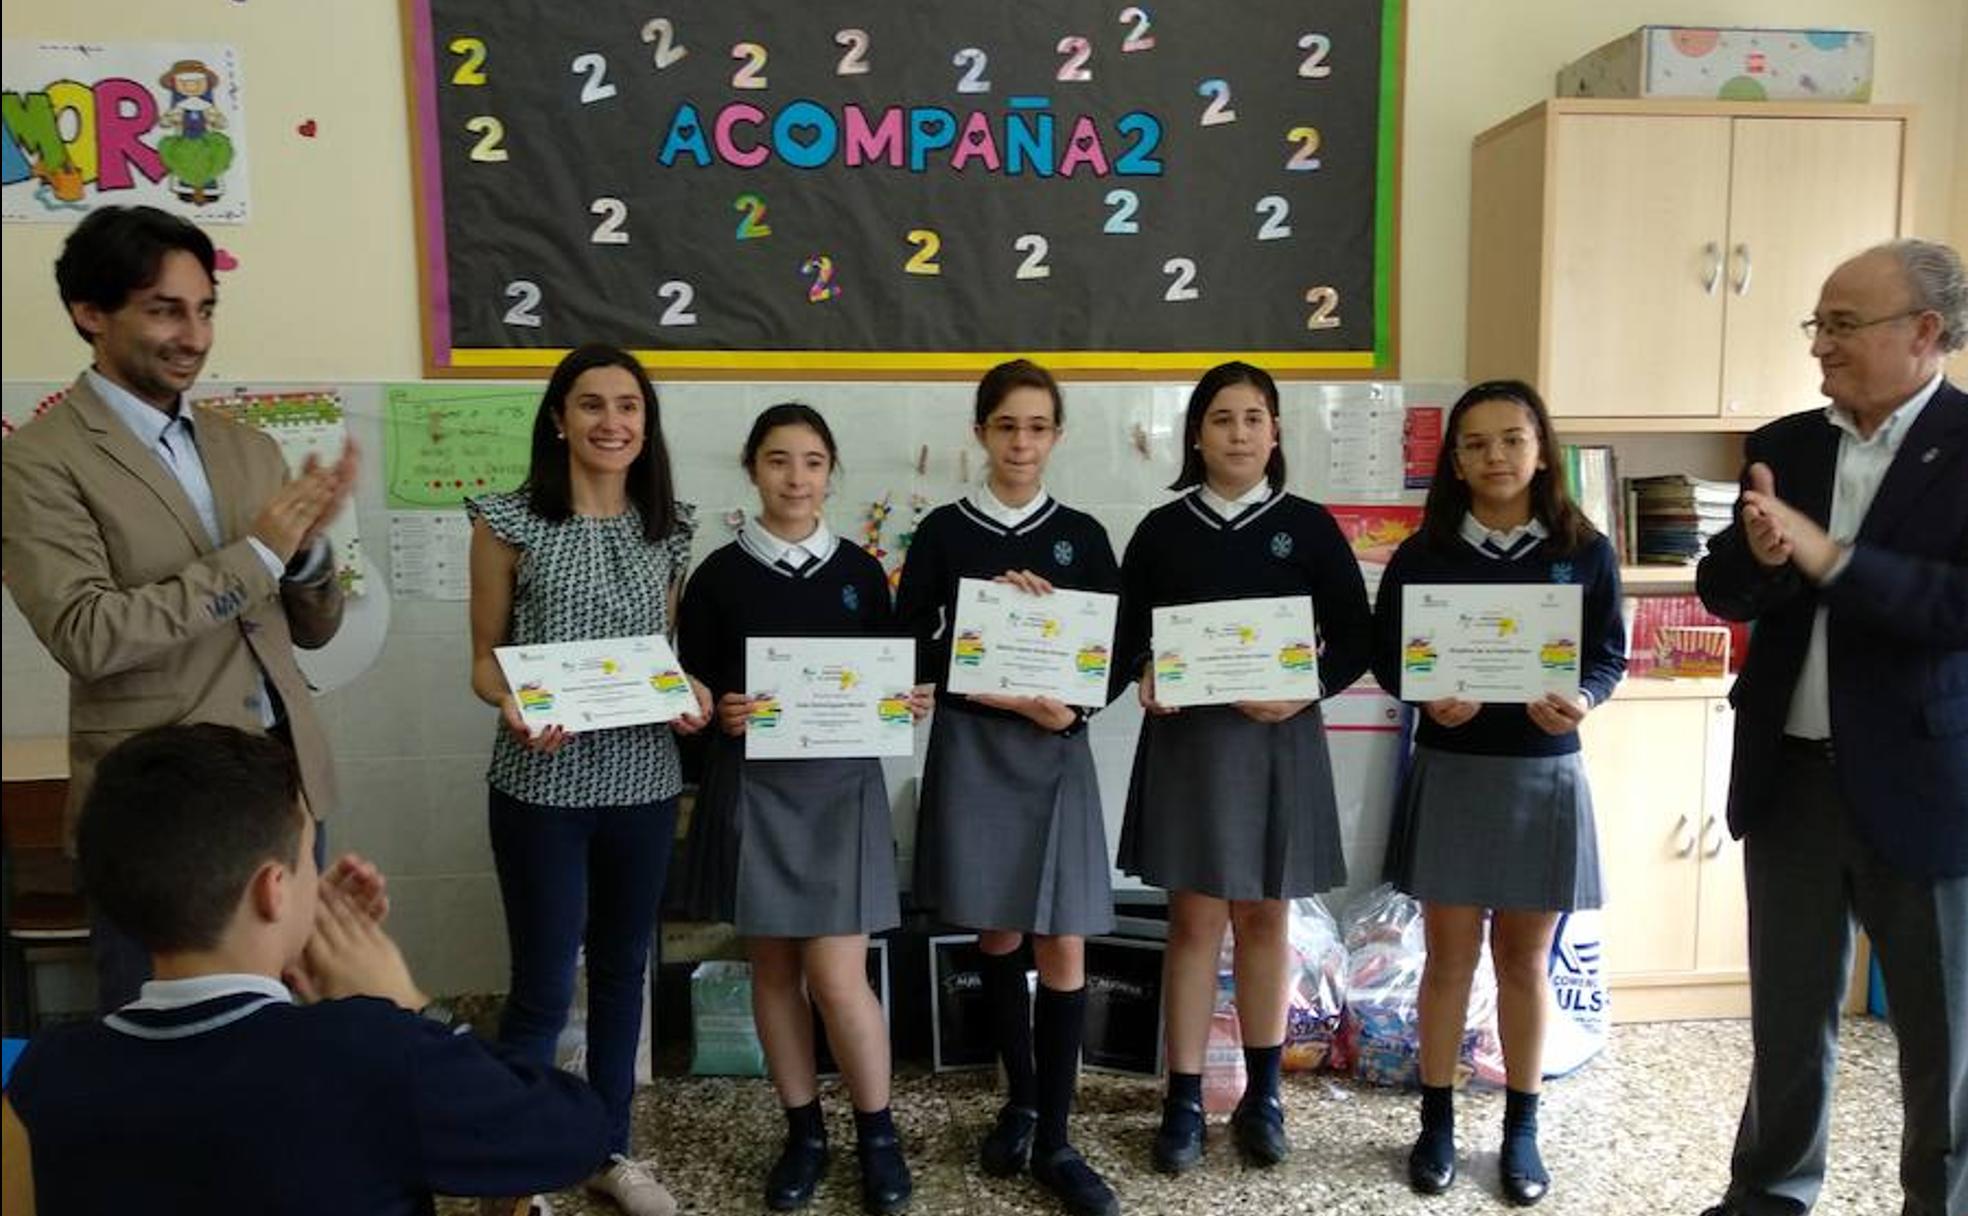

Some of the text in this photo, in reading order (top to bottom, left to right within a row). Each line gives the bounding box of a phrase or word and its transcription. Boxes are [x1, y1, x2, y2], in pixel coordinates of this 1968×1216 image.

[641, 18, 687, 69] 2
[835, 28, 869, 75] 2
[1118, 6, 1155, 53] 2
[450, 38, 486, 85] 2
[572, 53, 617, 104] 2
[731, 42, 767, 89] 2
[952, 47, 991, 94] 2
[1056, 35, 1093, 82] 2
[1298, 34, 1331, 78] 2
[1199, 79, 1236, 126] 2
[466, 116, 508, 162] 2
[657, 95, 1164, 178] ACOMPAÑA2
[1286, 127, 1321, 171] 2
[591, 197, 629, 244] 2
[736, 196, 771, 239] 2
[1103, 188, 1139, 234] 2
[1255, 195, 1291, 241] 2
[904, 229, 941, 275] 2
[1014, 234, 1050, 280] 2
[801, 257, 841, 302] 2
[1162, 257, 1199, 302] 2
[503, 281, 541, 327] 2
[658, 280, 697, 326] 2
[1305, 286, 1340, 329] 2
